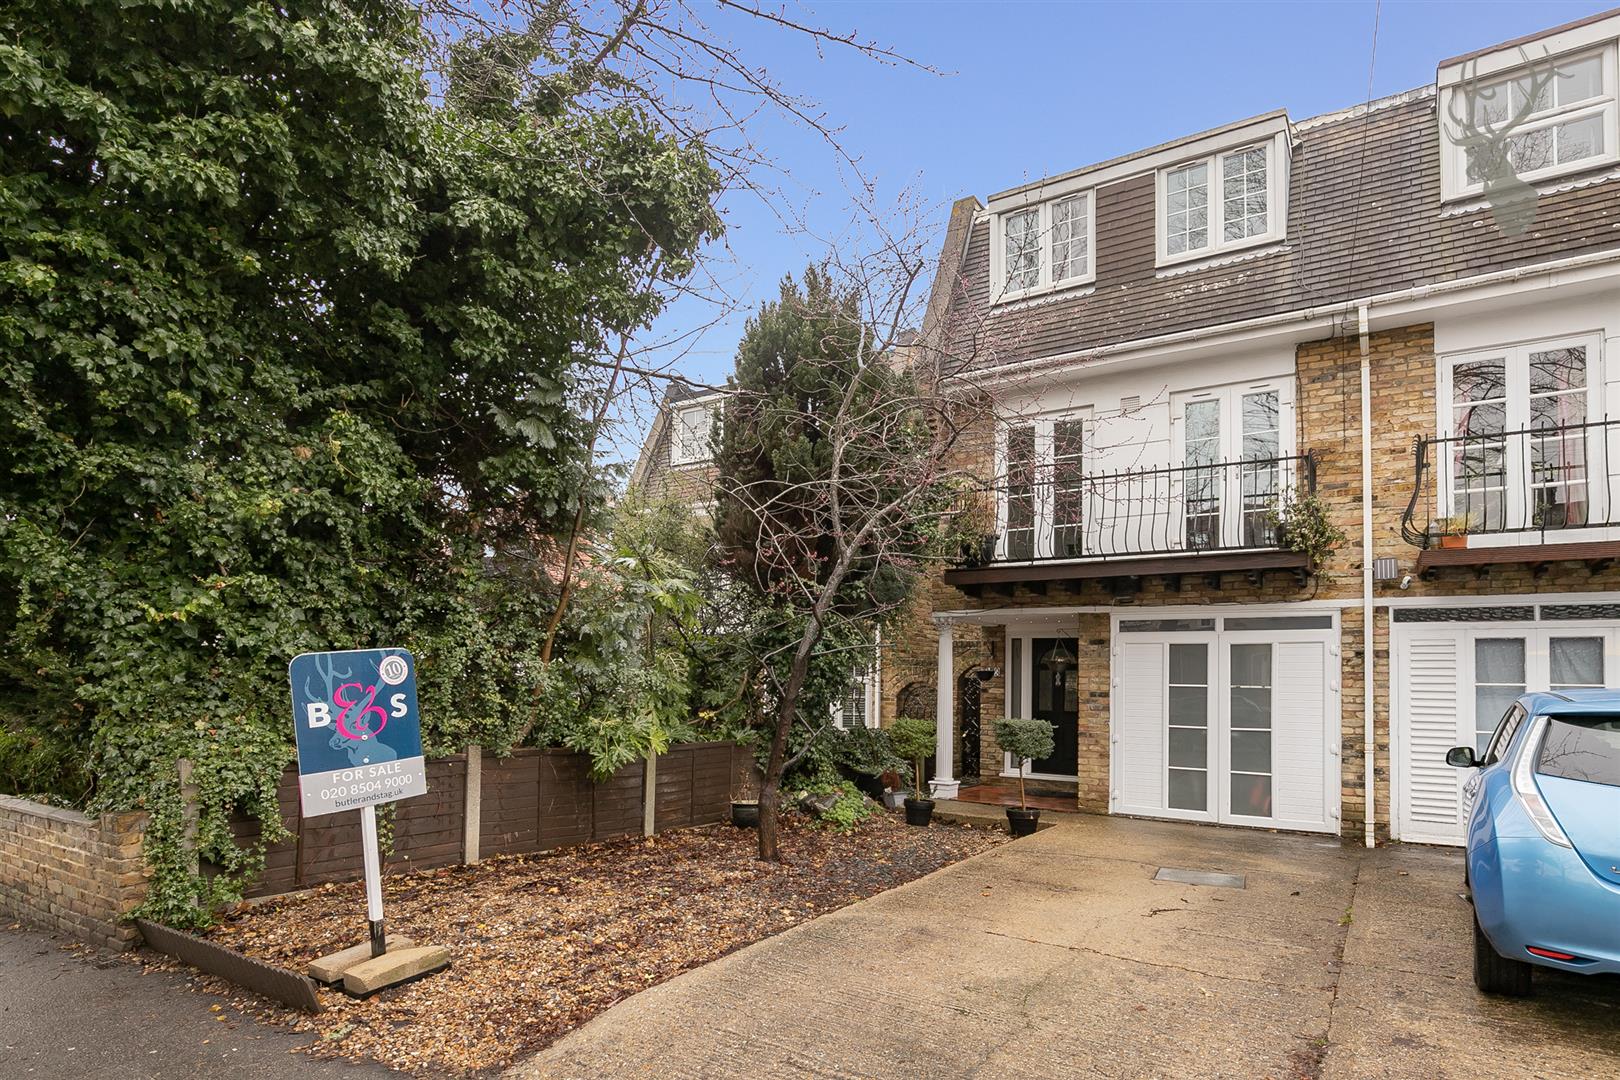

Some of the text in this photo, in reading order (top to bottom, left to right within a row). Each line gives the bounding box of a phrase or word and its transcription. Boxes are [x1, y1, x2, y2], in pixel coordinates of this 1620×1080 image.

[307, 702, 331, 729] B
[390, 693, 408, 718] S
[332, 762, 402, 784] FOR SALE
[320, 774, 413, 800] 020 8504 9000
[335, 788, 404, 808] butlerandstag.uk
